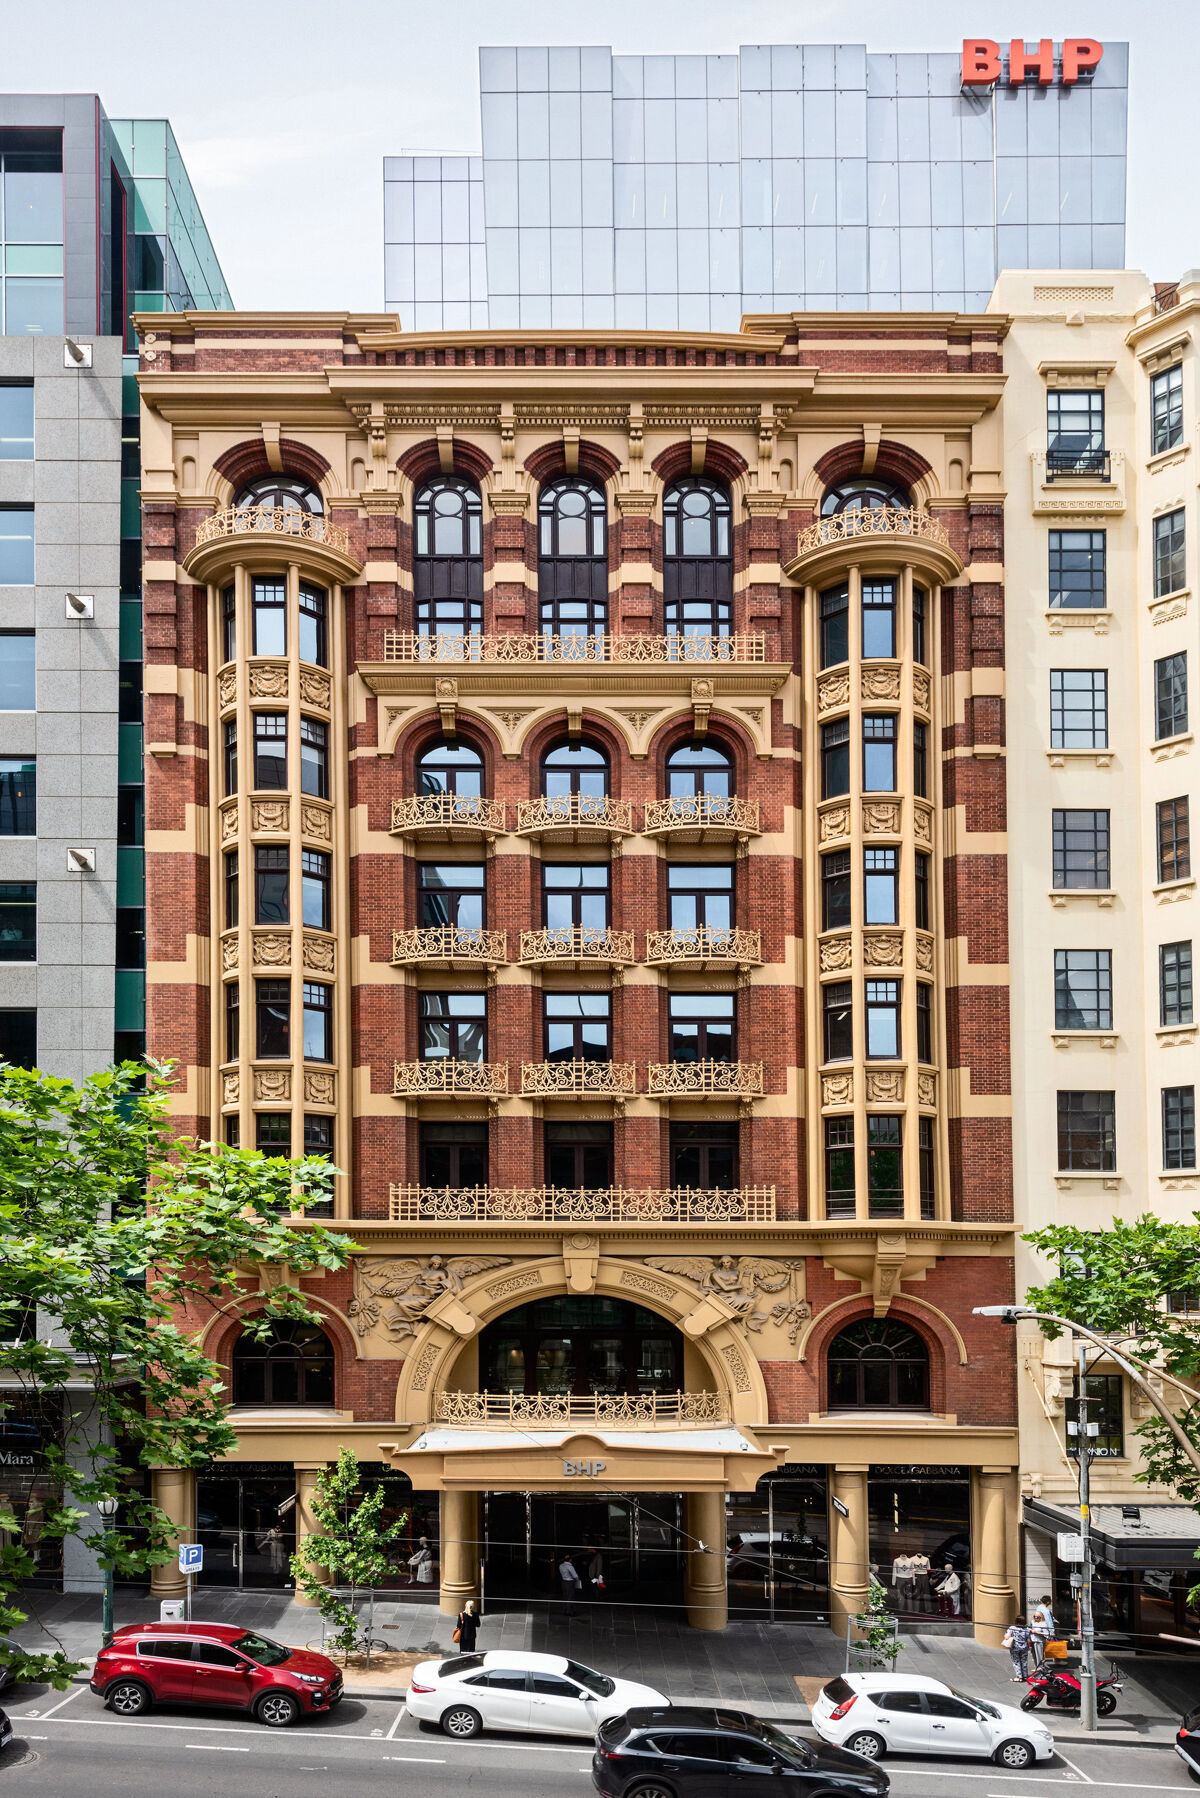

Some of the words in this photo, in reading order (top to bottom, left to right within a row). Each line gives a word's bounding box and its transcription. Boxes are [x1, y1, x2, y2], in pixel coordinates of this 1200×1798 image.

[962, 39, 1104, 85] BHP
[563, 1461, 606, 1476] BHP
[189, 1549, 198, 1562] P
